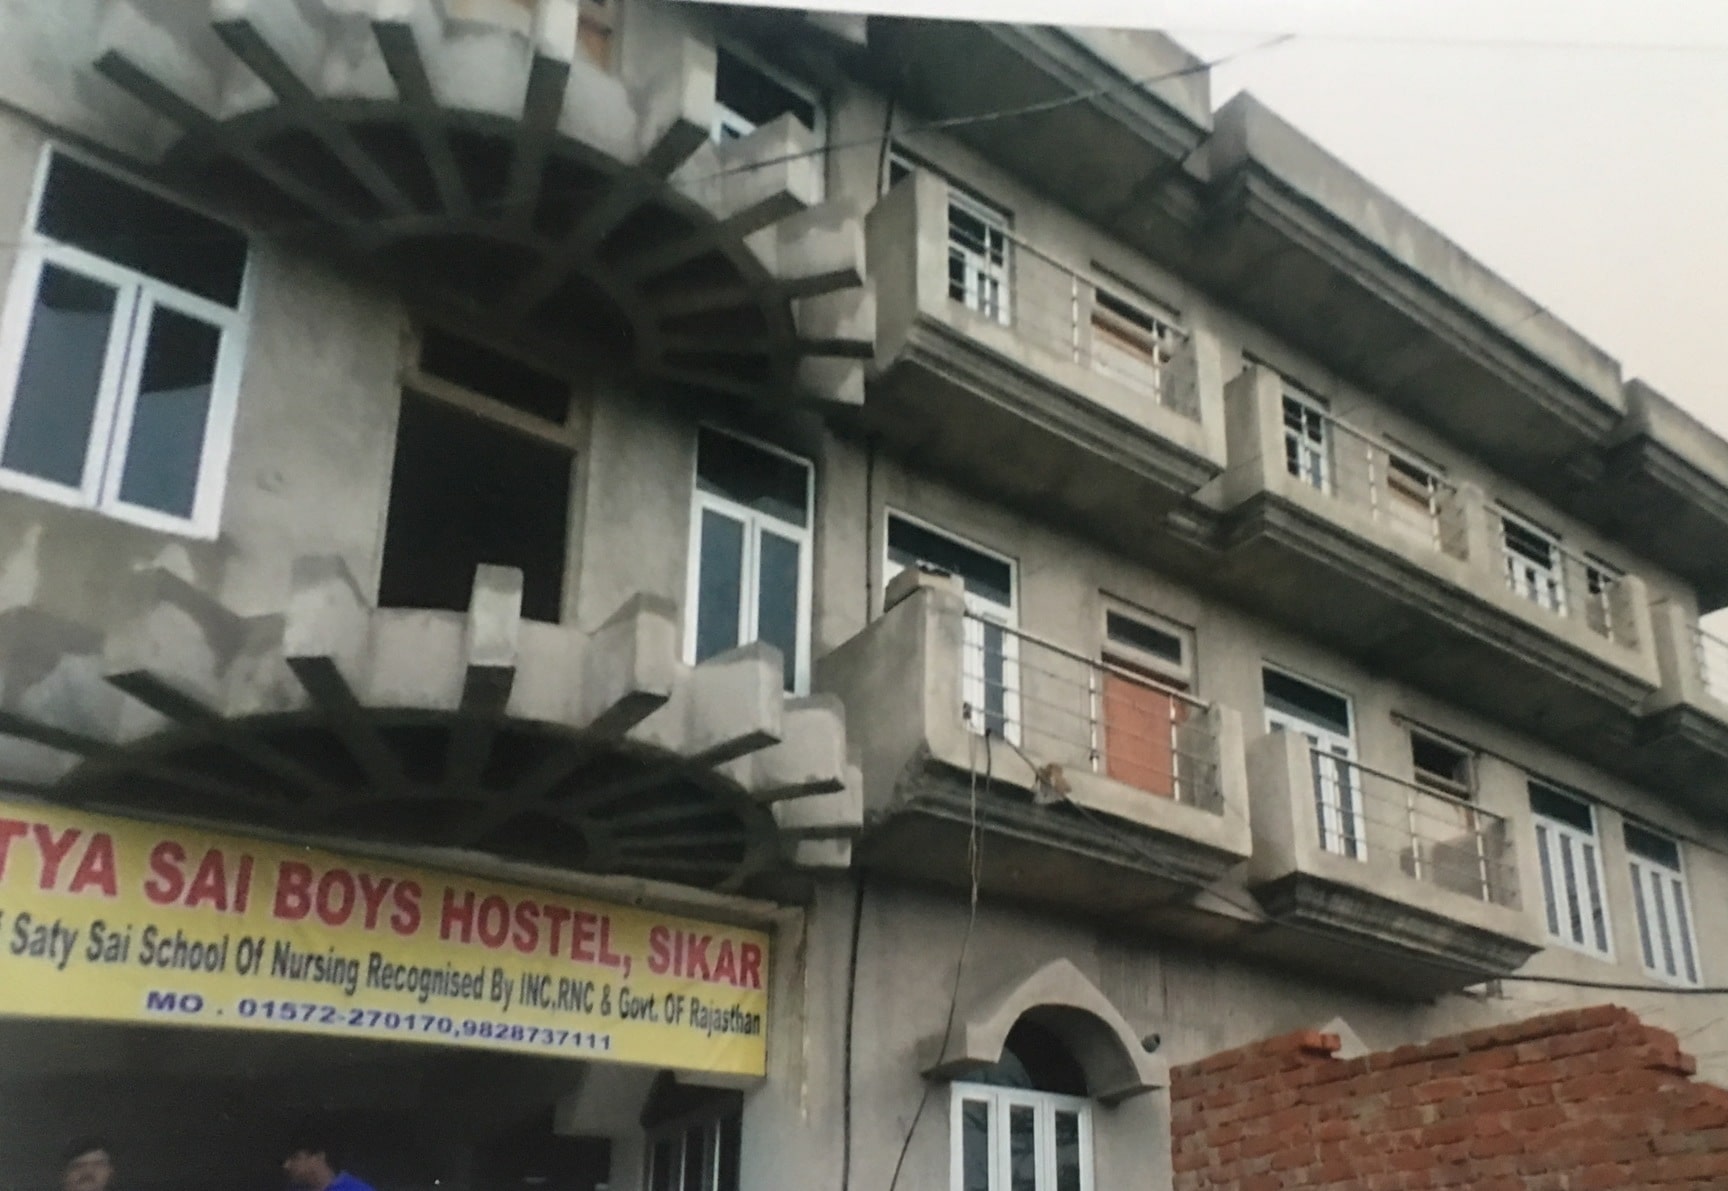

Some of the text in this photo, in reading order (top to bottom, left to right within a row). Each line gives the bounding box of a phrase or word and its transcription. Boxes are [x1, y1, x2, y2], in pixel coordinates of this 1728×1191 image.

[10, 911, 77, 970] Saty
[86, 919, 132, 962] Sai
[139, 924, 229, 973] School
[236, 935, 265, 976] Of
[271, 939, 359, 996] Nursing
[366, 951, 486, 1002] Recognised
[489, 966, 514, 1013] By
[600, 984, 612, 1017] &
[664, 992, 684, 1025] OF
[690, 999, 761, 1038] Rajasthan
[144, 841, 254, 914] SAI
[273, 860, 422, 937] BOYS
[440, 886, 631, 978] HOSTEL,
[647, 925, 762, 989] SIKAR
[146, 990, 203, 1013] MO
